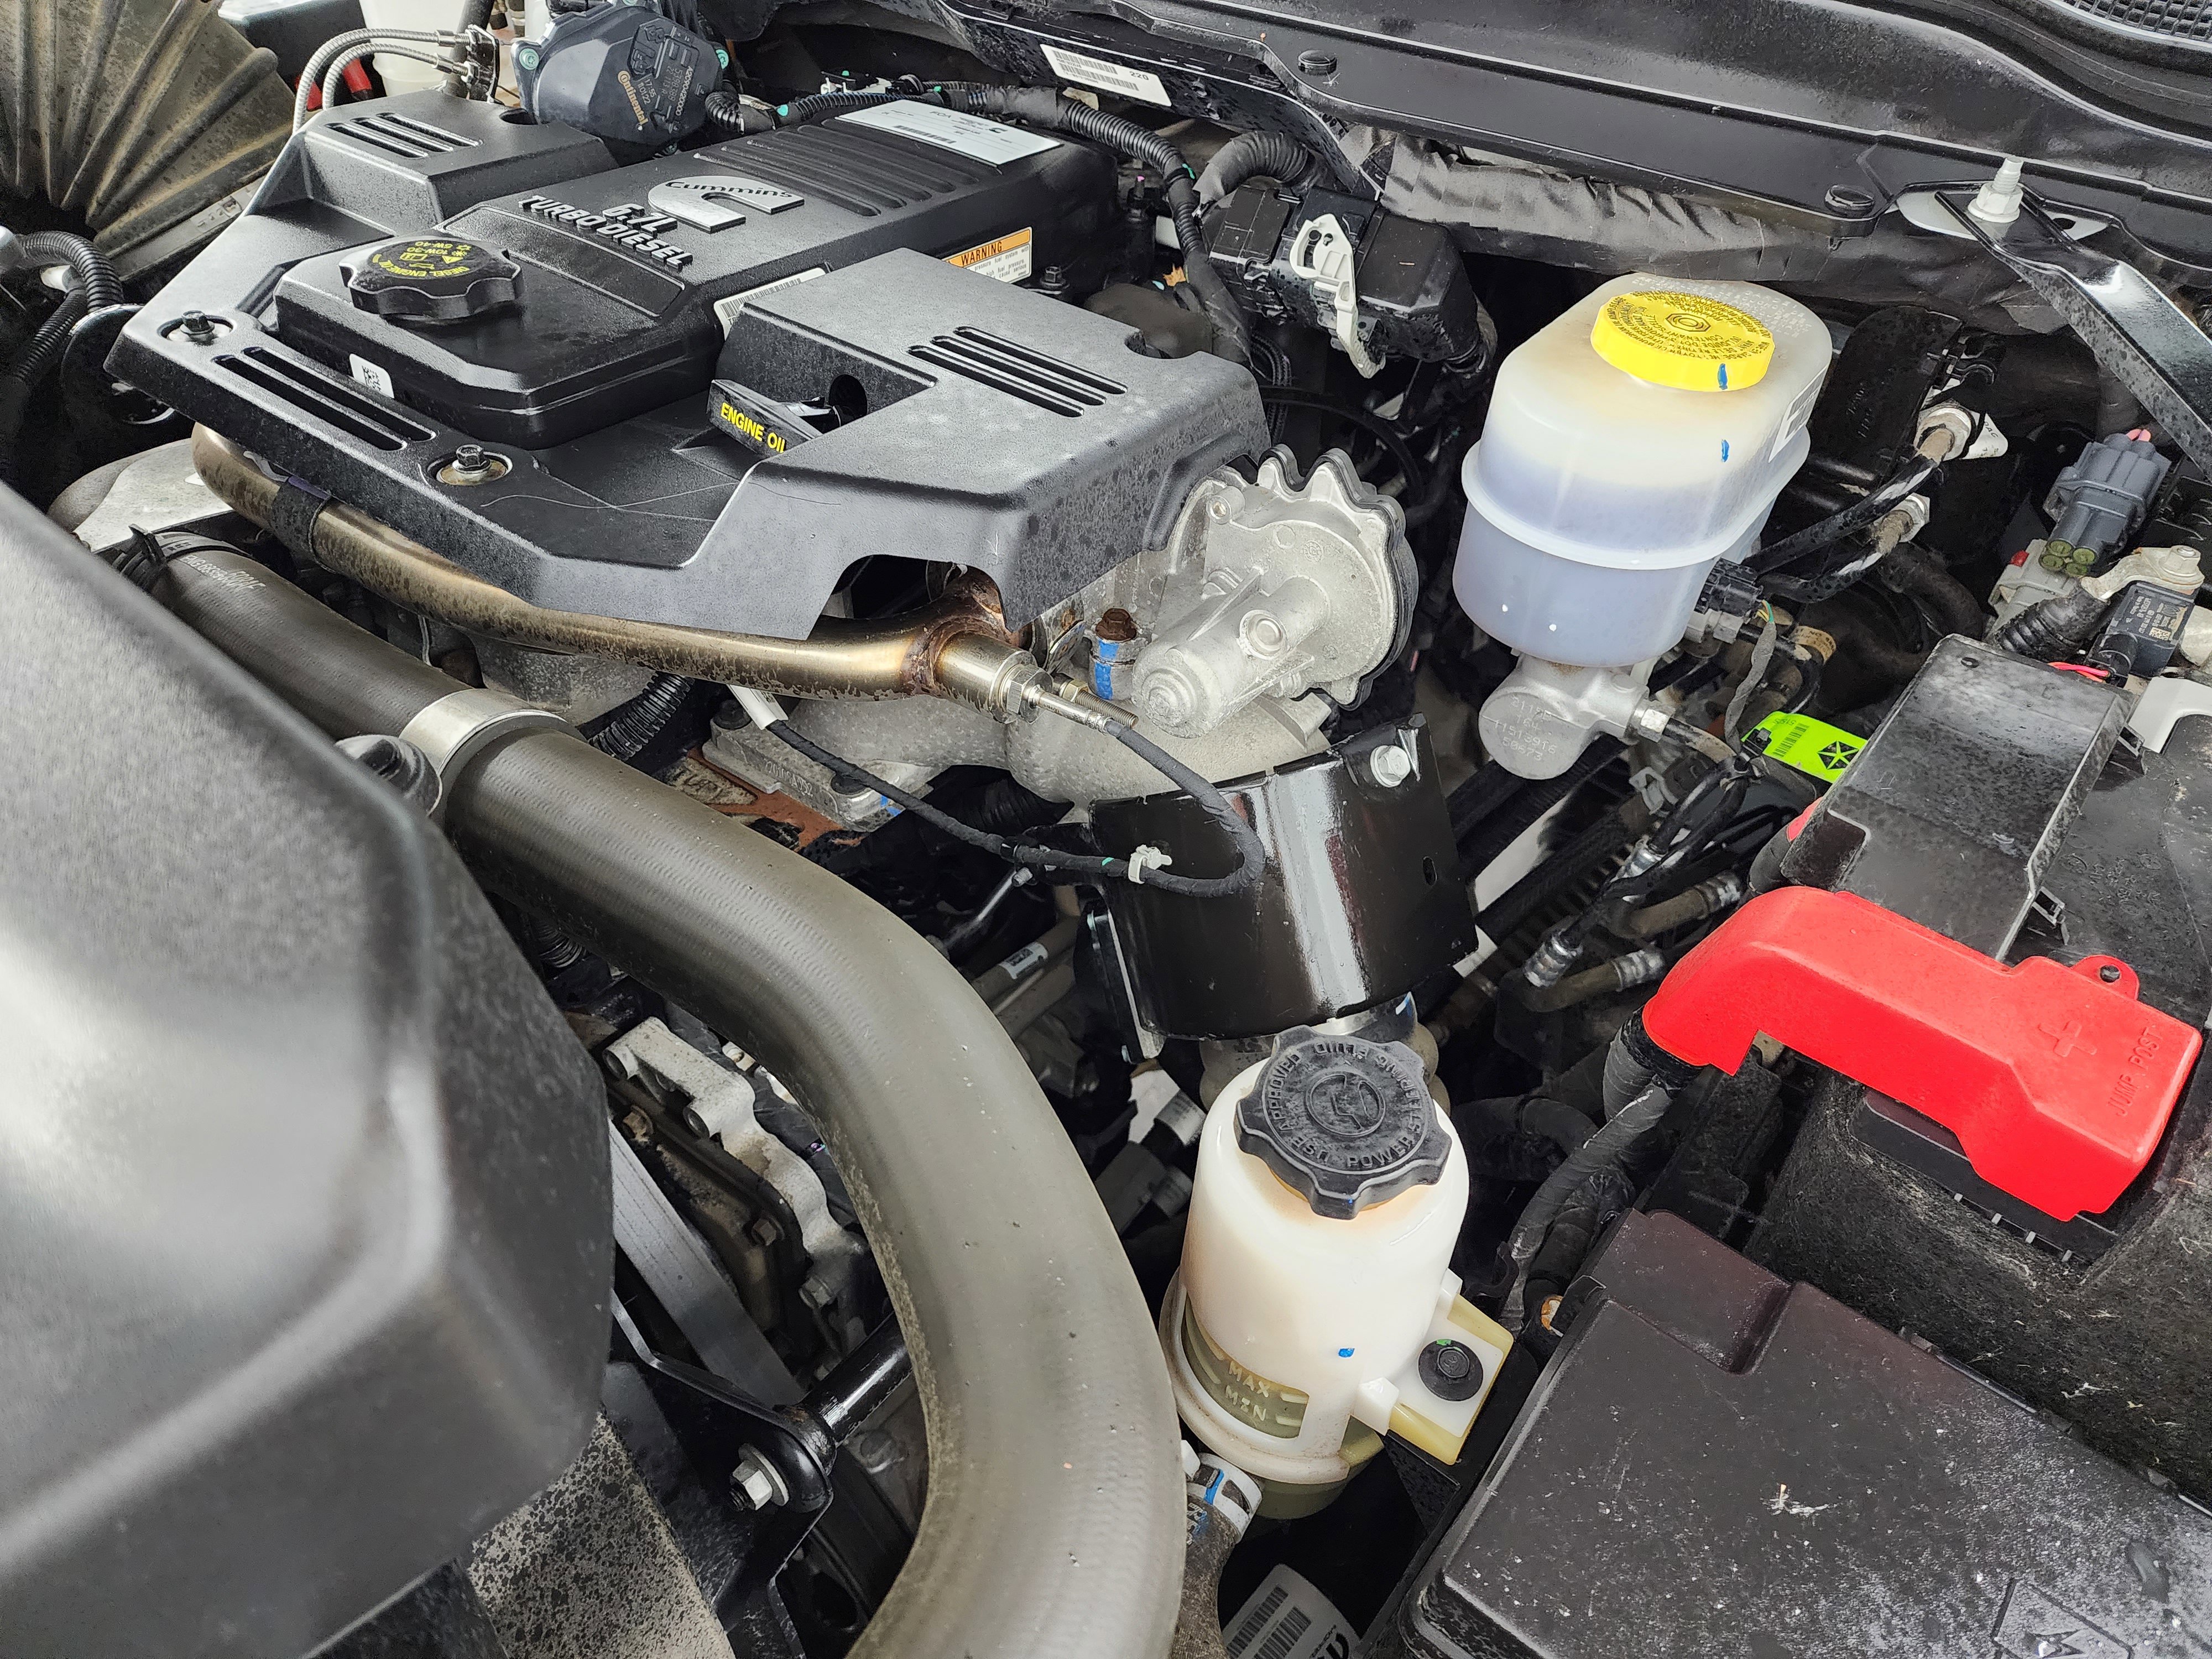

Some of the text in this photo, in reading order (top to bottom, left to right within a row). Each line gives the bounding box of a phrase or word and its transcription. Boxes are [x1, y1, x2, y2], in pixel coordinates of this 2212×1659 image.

[1129, 70, 1150, 81] 220
[617, 70, 649, 125] Continental
[518, 195, 693, 270] TURBO DIESEL
[429, 266, 470, 277] DIESEL
[961, 241, 1003, 266] WARNING
[721, 402, 785, 453] ENGINE OIL
[2107, 1026, 2164, 1117] JUMP POST
[1268, 1053, 1301, 1131] APPROVED
[1345, 1135, 1414, 1168] POWER
[1228, 1360, 1270, 1398] MAX
[1224, 1384, 1267, 1421] MIN
